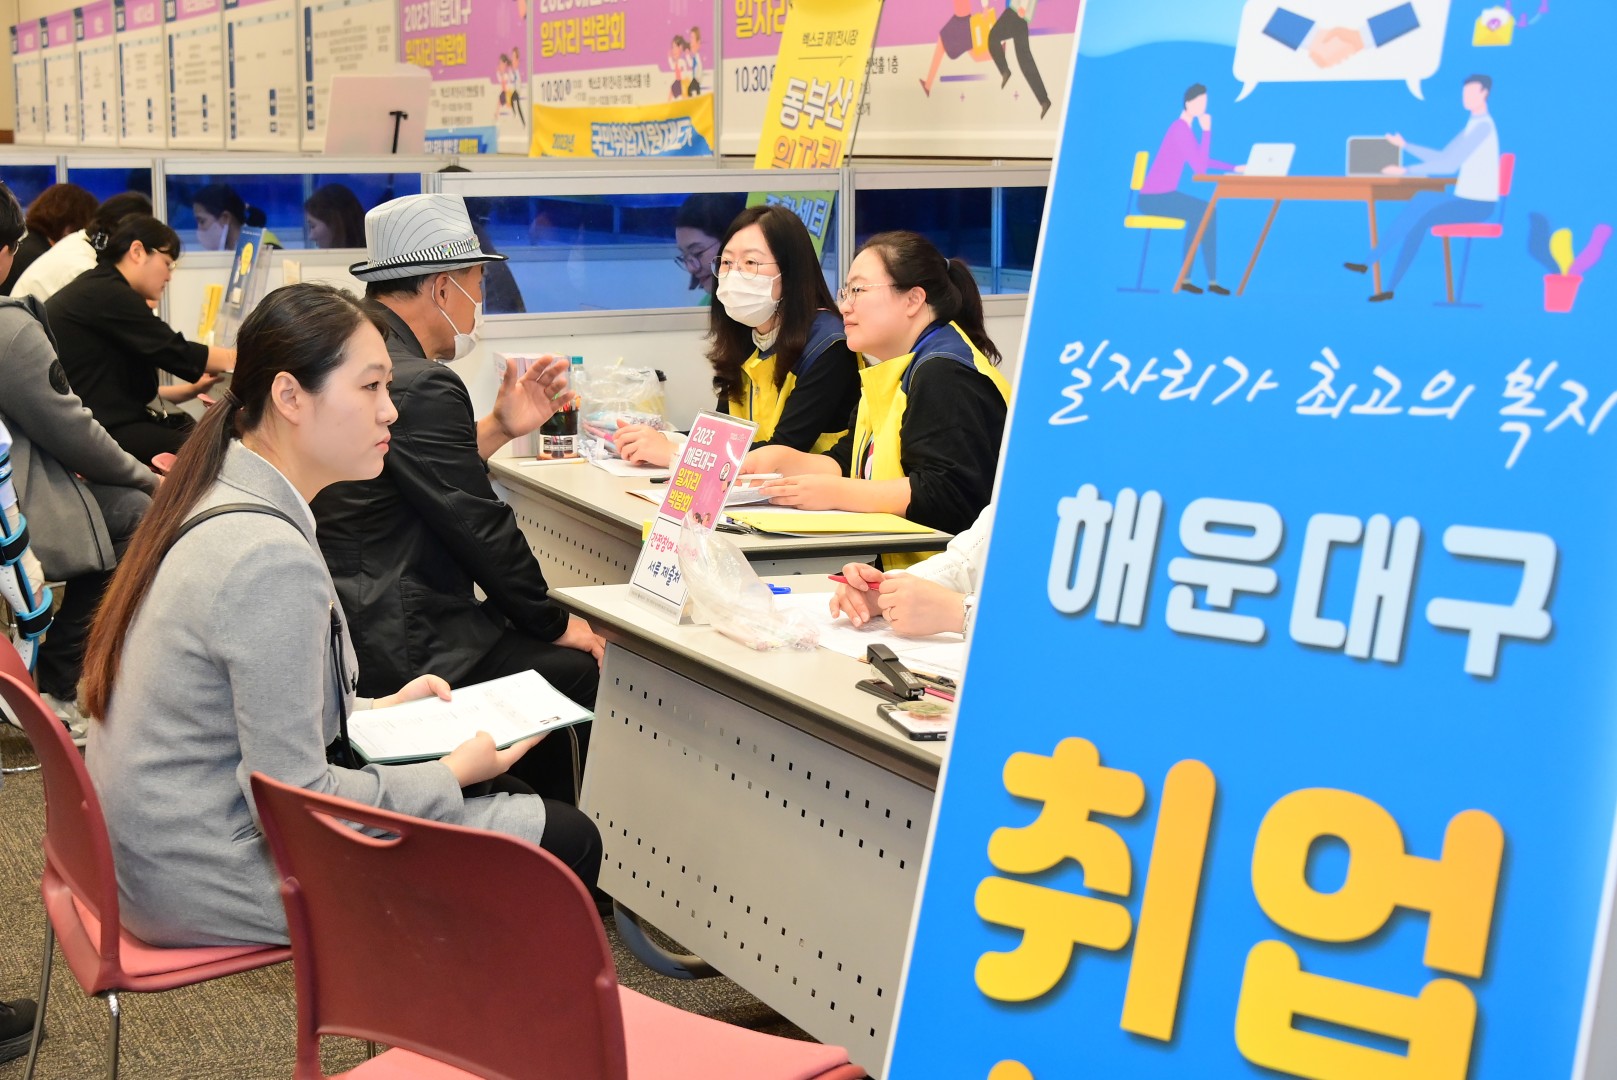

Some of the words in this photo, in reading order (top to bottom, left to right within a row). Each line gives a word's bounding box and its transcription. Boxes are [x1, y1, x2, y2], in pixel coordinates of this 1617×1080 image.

[541, 18, 581, 58] 일자리
[582, 11, 625, 53] 박람회
[802, 32, 824, 47] 벡스코
[780, 76, 854, 129] 동부산
[772, 135, 841, 169] 일자리
[1048, 340, 1279, 425] 일자리가
[1296, 347, 1476, 419] 최고의
[1499, 358, 1617, 469] 복지
[692, 426, 716, 446] 2023
[684, 446, 718, 472] 해운대구
[675, 467, 702, 492] 일자리
[667, 489, 693, 513] 박람회
[648, 560, 662, 578] 서류
[1047, 483, 1557, 677] 해운대구
[974, 736, 1505, 1080] 취업
